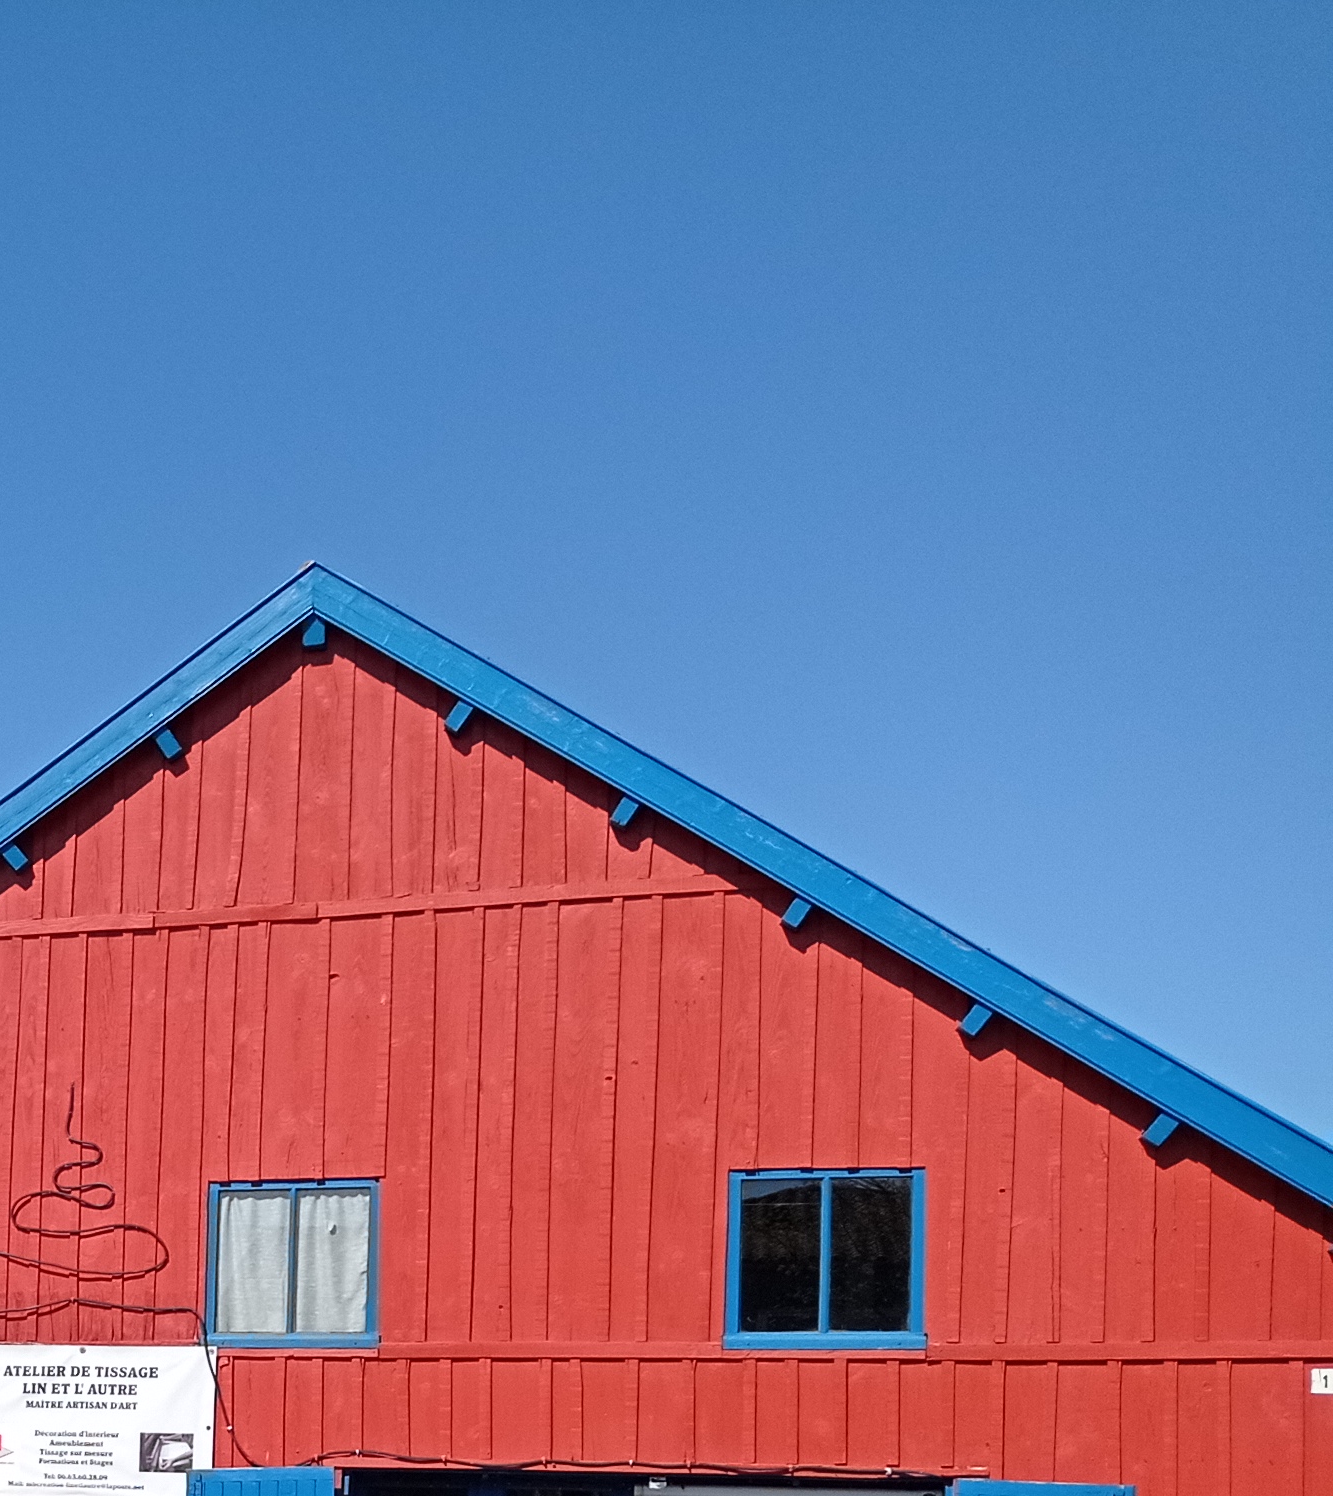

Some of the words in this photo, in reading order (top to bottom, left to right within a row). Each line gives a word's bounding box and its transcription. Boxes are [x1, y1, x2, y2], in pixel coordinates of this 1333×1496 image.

[3, 1365, 65, 1377] ATELIER
[70, 1365, 91, 1378] DE
[95, 1366, 159, 1379] TISSAGE
[22, 1382, 47, 1394] LIN
[51, 1383, 70, 1395] ET
[87, 1384, 138, 1396] AUTRE
[65, 1400, 108, 1410] ARTISAN
